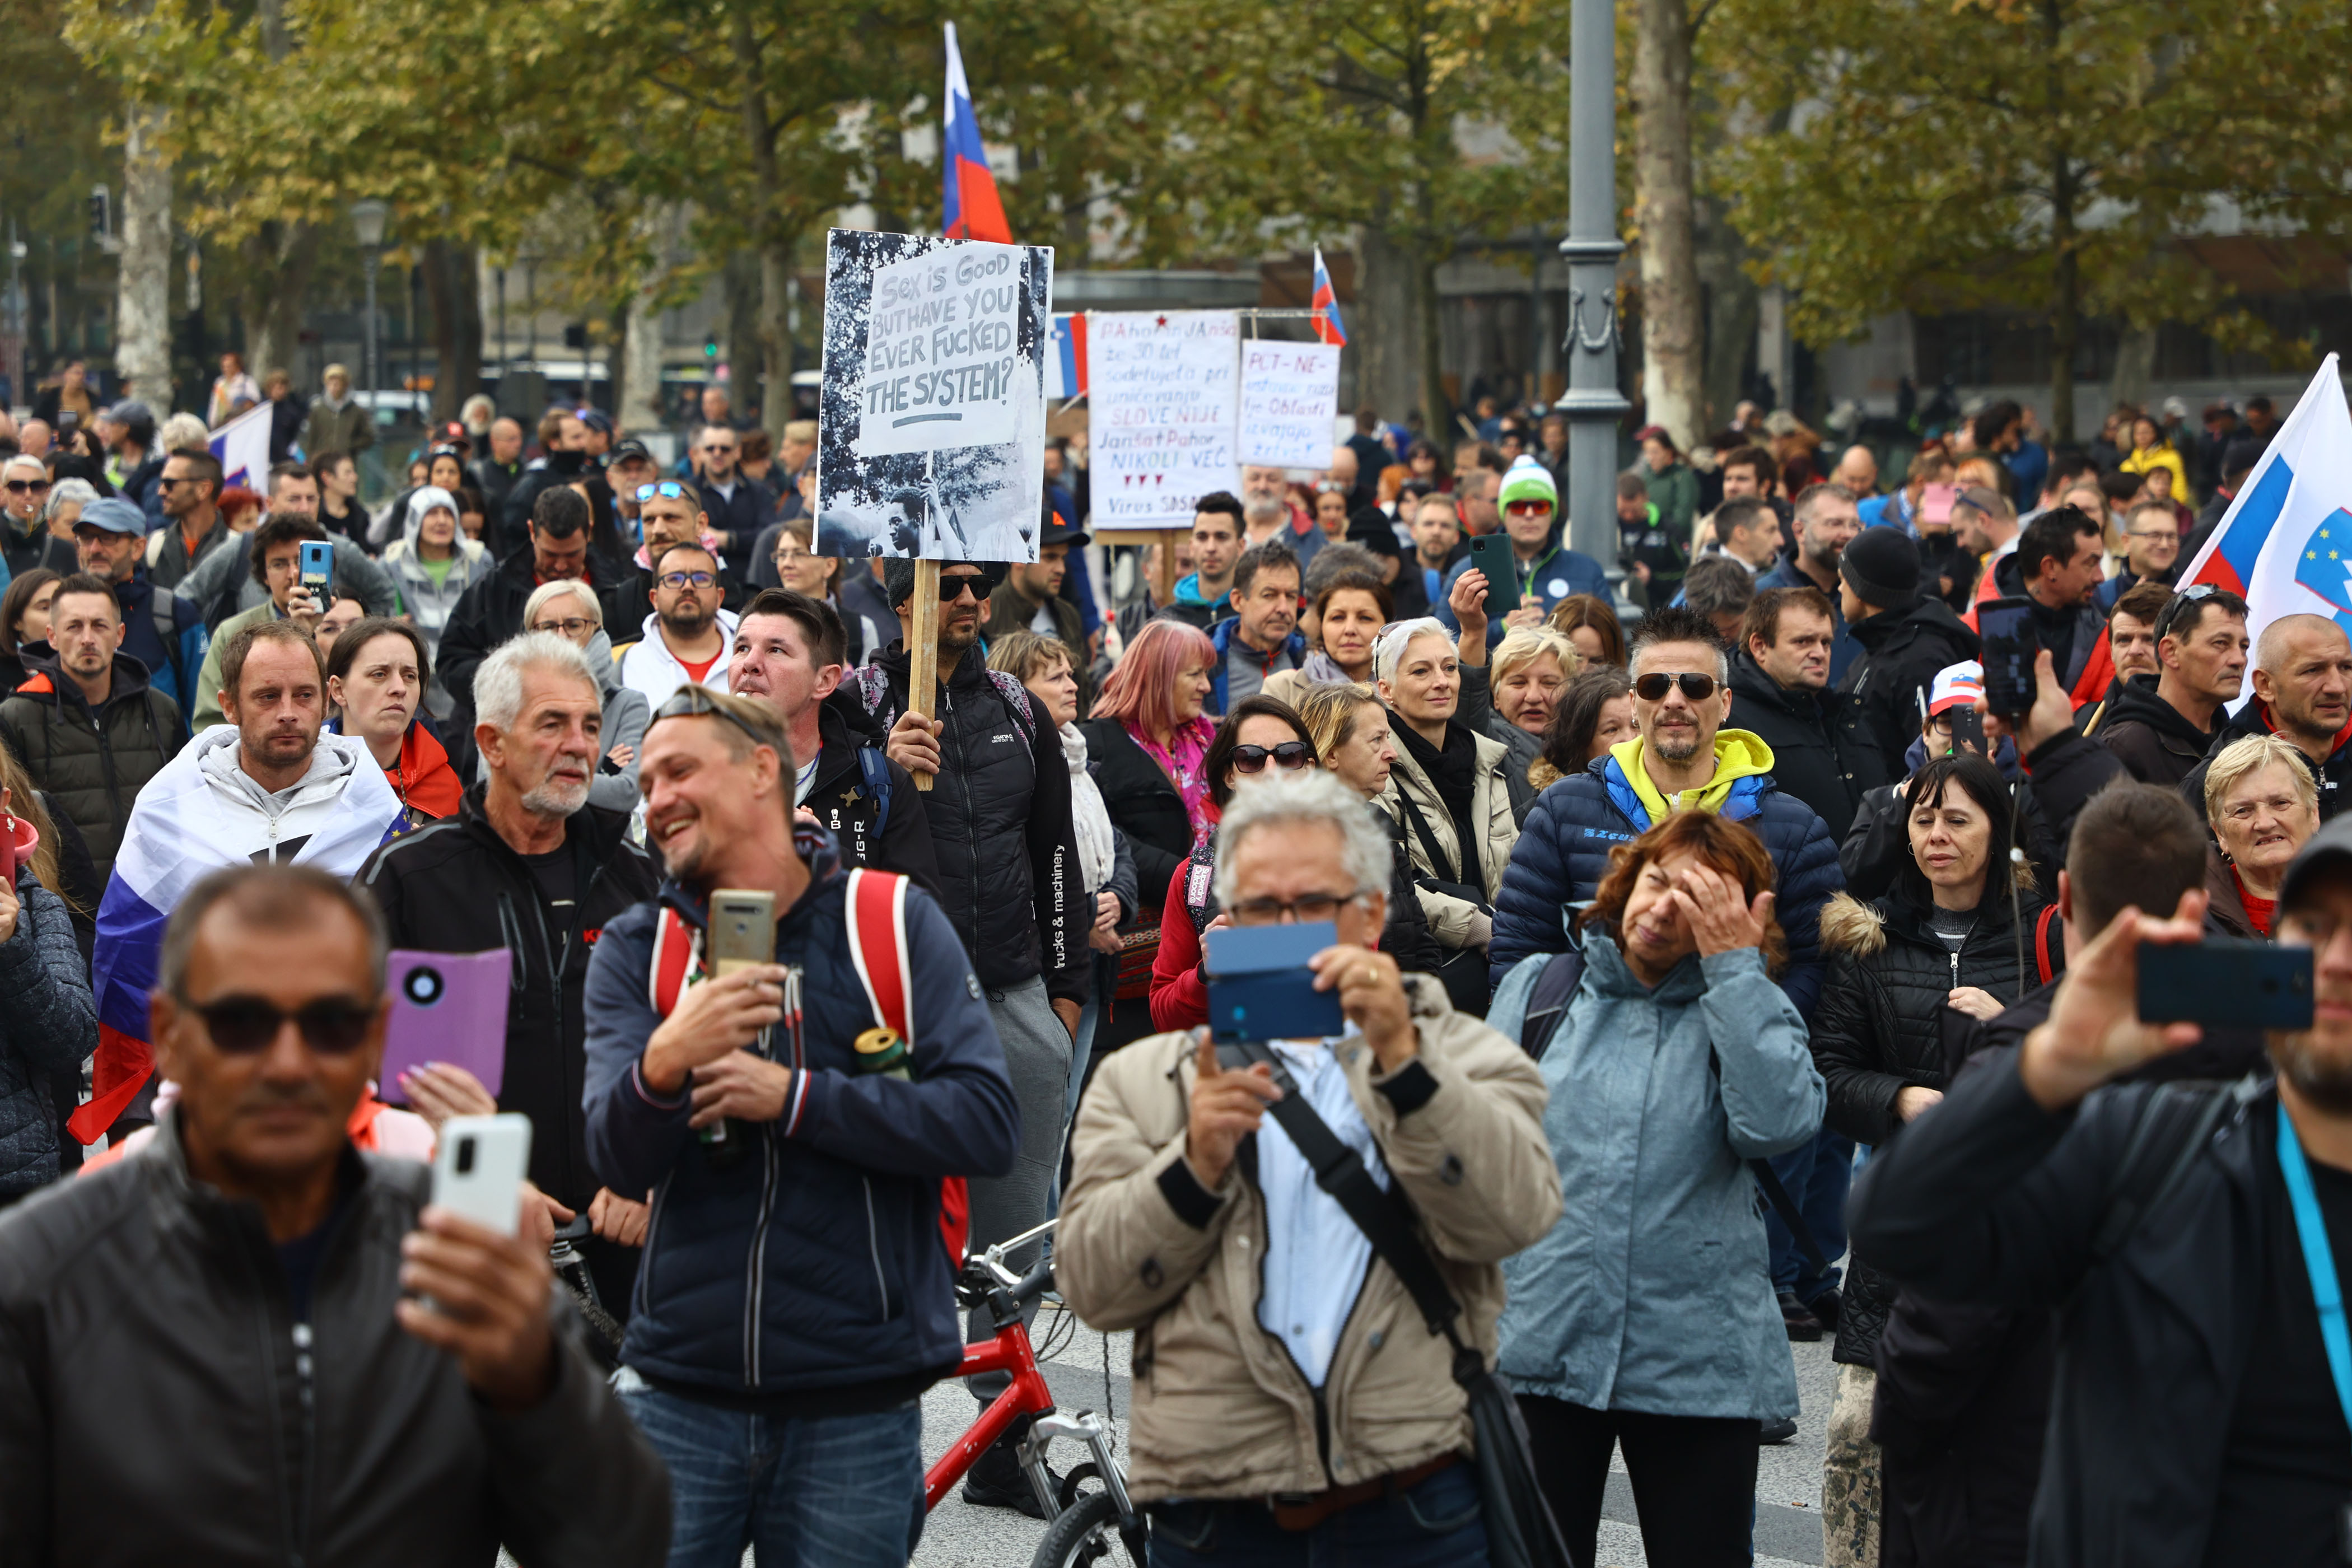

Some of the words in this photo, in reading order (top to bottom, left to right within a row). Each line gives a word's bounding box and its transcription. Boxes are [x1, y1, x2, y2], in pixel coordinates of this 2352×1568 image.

[963, 284, 1014, 319] YOU
[870, 335, 926, 374] EVER
[866, 376, 910, 414] THE
[912, 356, 1014, 407] SYSTEM?
[1051, 844, 1066, 912] machinery
[1195, 868, 1210, 903] Superdry
[1053, 930, 1066, 969] trucks
